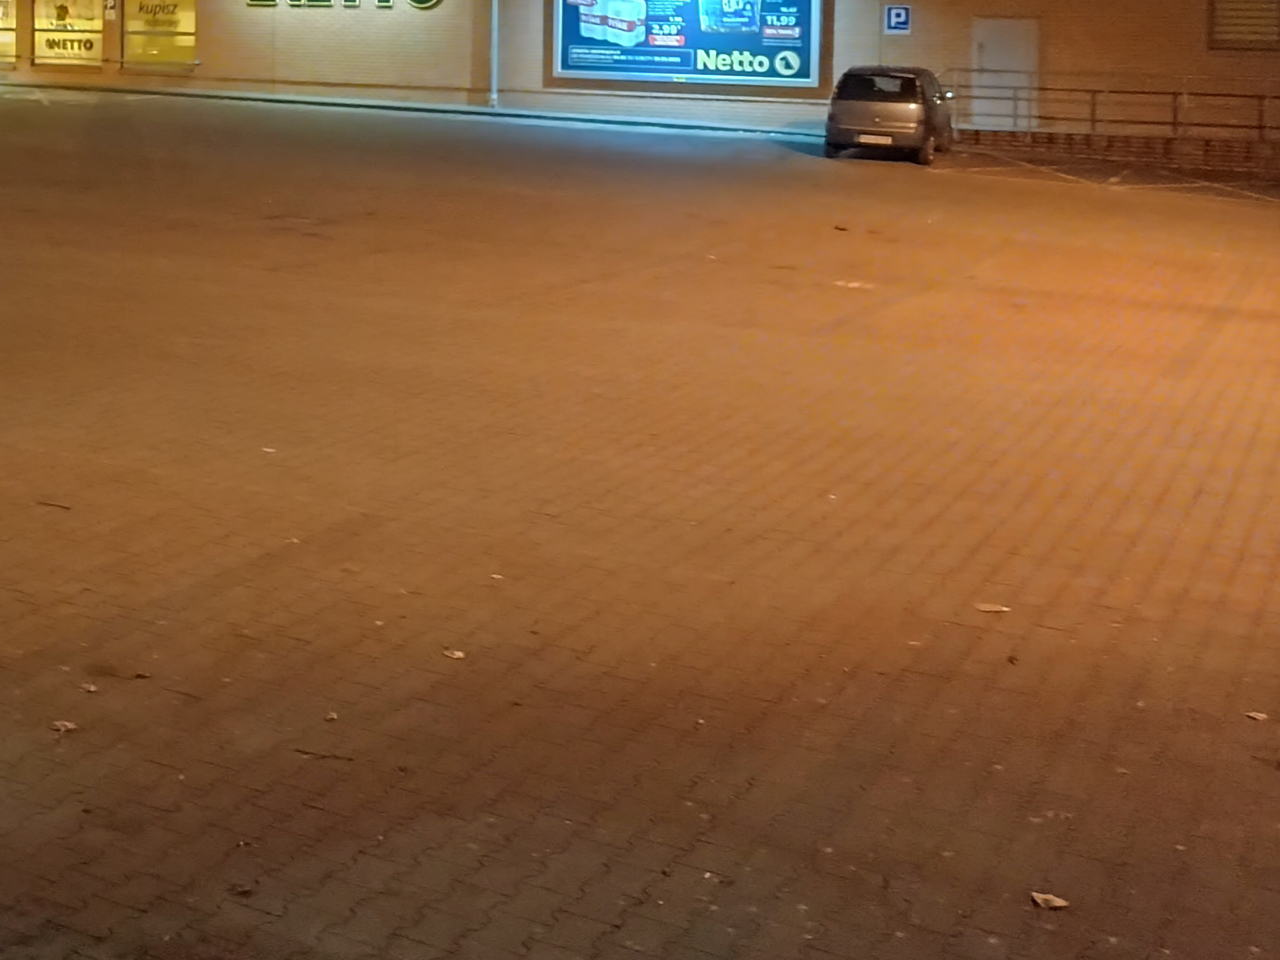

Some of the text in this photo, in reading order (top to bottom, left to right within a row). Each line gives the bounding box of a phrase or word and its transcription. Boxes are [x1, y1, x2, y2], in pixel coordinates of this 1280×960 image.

[138, 0, 179, 17] kupisz
[890, 8, 906, 28] P
[50, 38, 94, 52] NETTO
[696, 48, 770, 73] Netto
